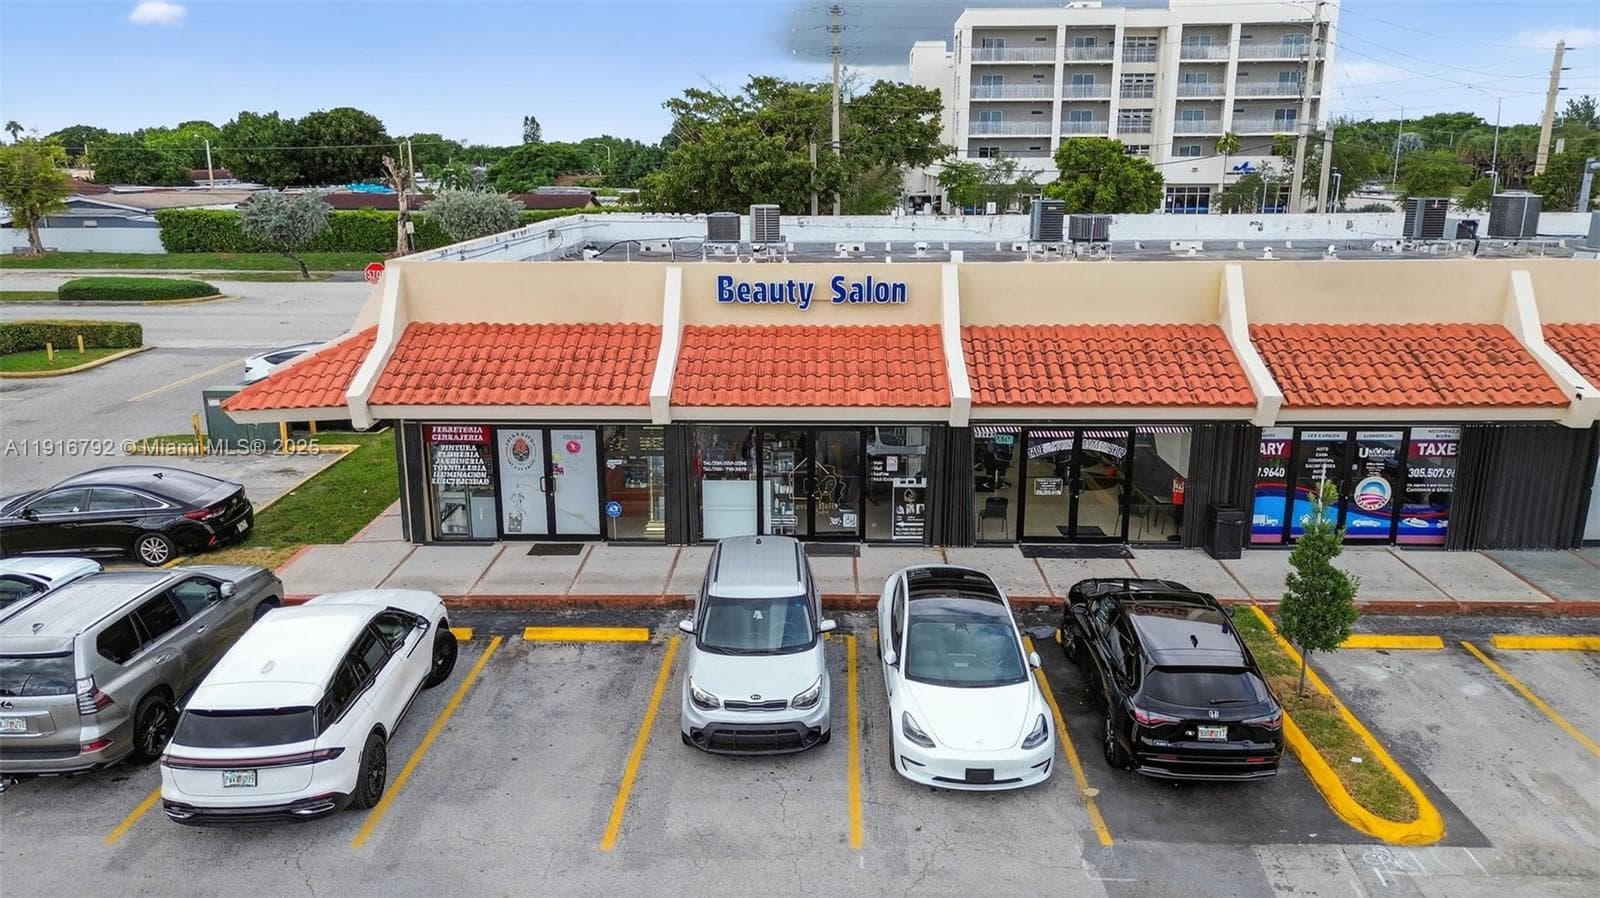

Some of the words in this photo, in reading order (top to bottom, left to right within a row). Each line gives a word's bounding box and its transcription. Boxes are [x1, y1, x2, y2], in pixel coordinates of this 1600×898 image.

[367, 270, 384, 279] STO
[716, 273, 815, 310] Beauty
[830, 273, 907, 304] Salon
[1417, 442, 1459, 456] TAXE
